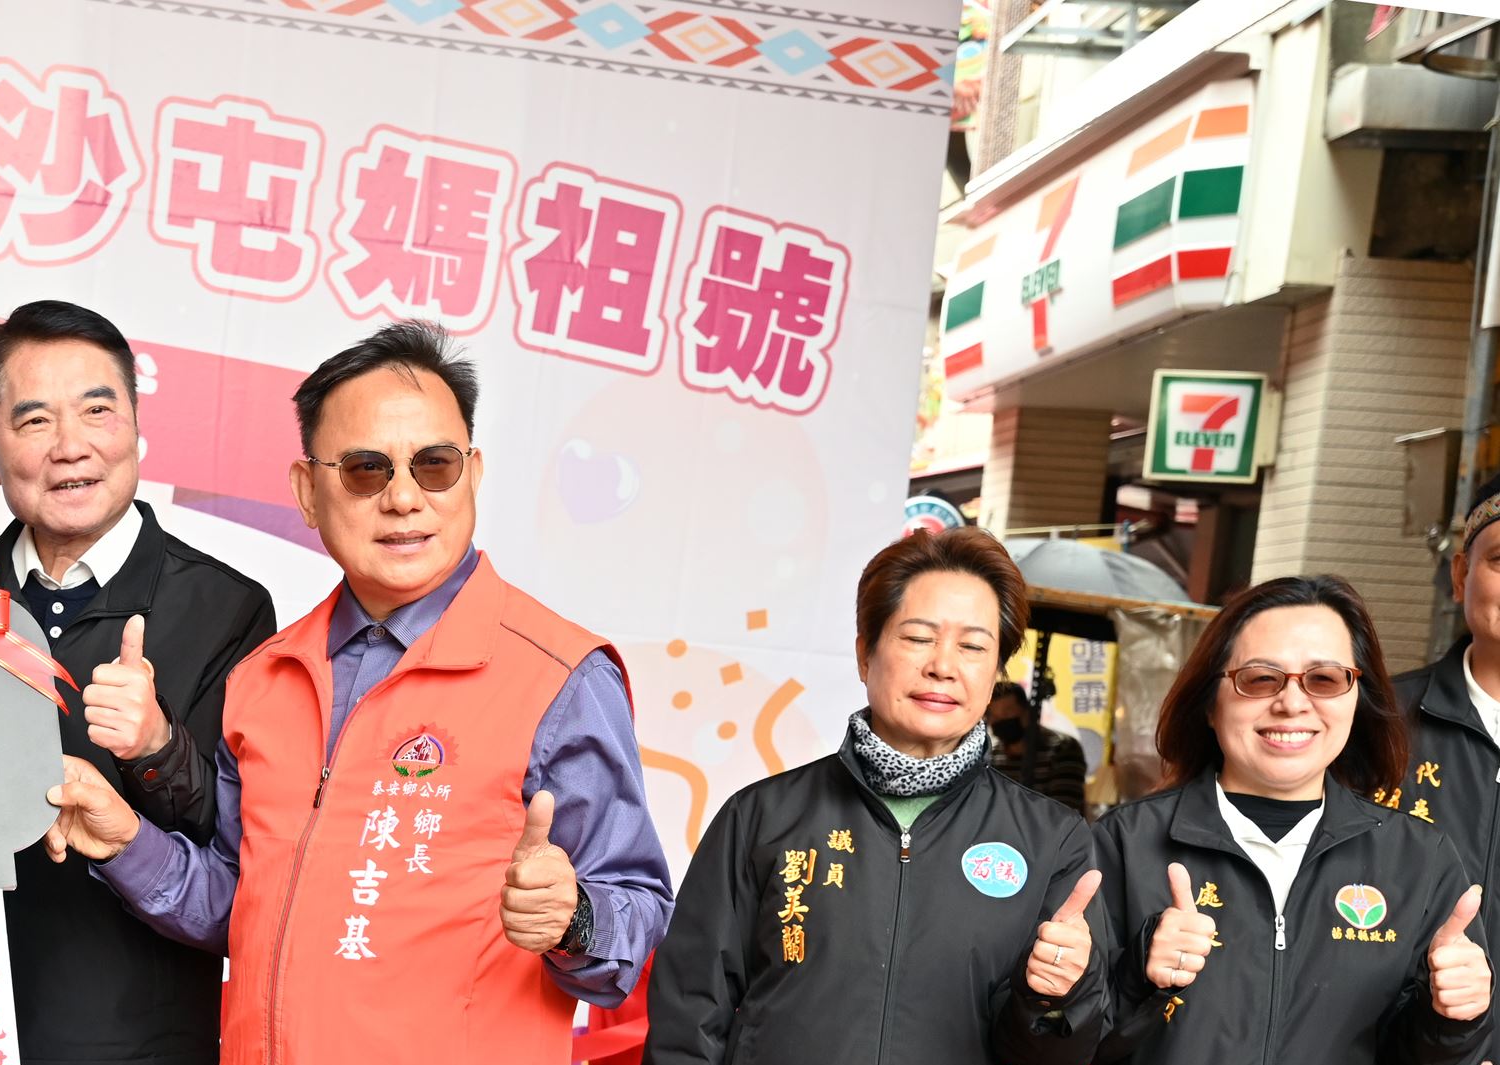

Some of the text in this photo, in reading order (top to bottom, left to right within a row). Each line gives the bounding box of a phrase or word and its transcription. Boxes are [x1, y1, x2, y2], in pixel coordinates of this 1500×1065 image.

[371, 780, 452, 800] 泰安鄉公所
[405, 808, 443, 874] 鄉長
[822, 829, 855, 889] 議員
[334, 805, 400, 960] 陳吉基
[777, 848, 818, 963] 劉美蘭
